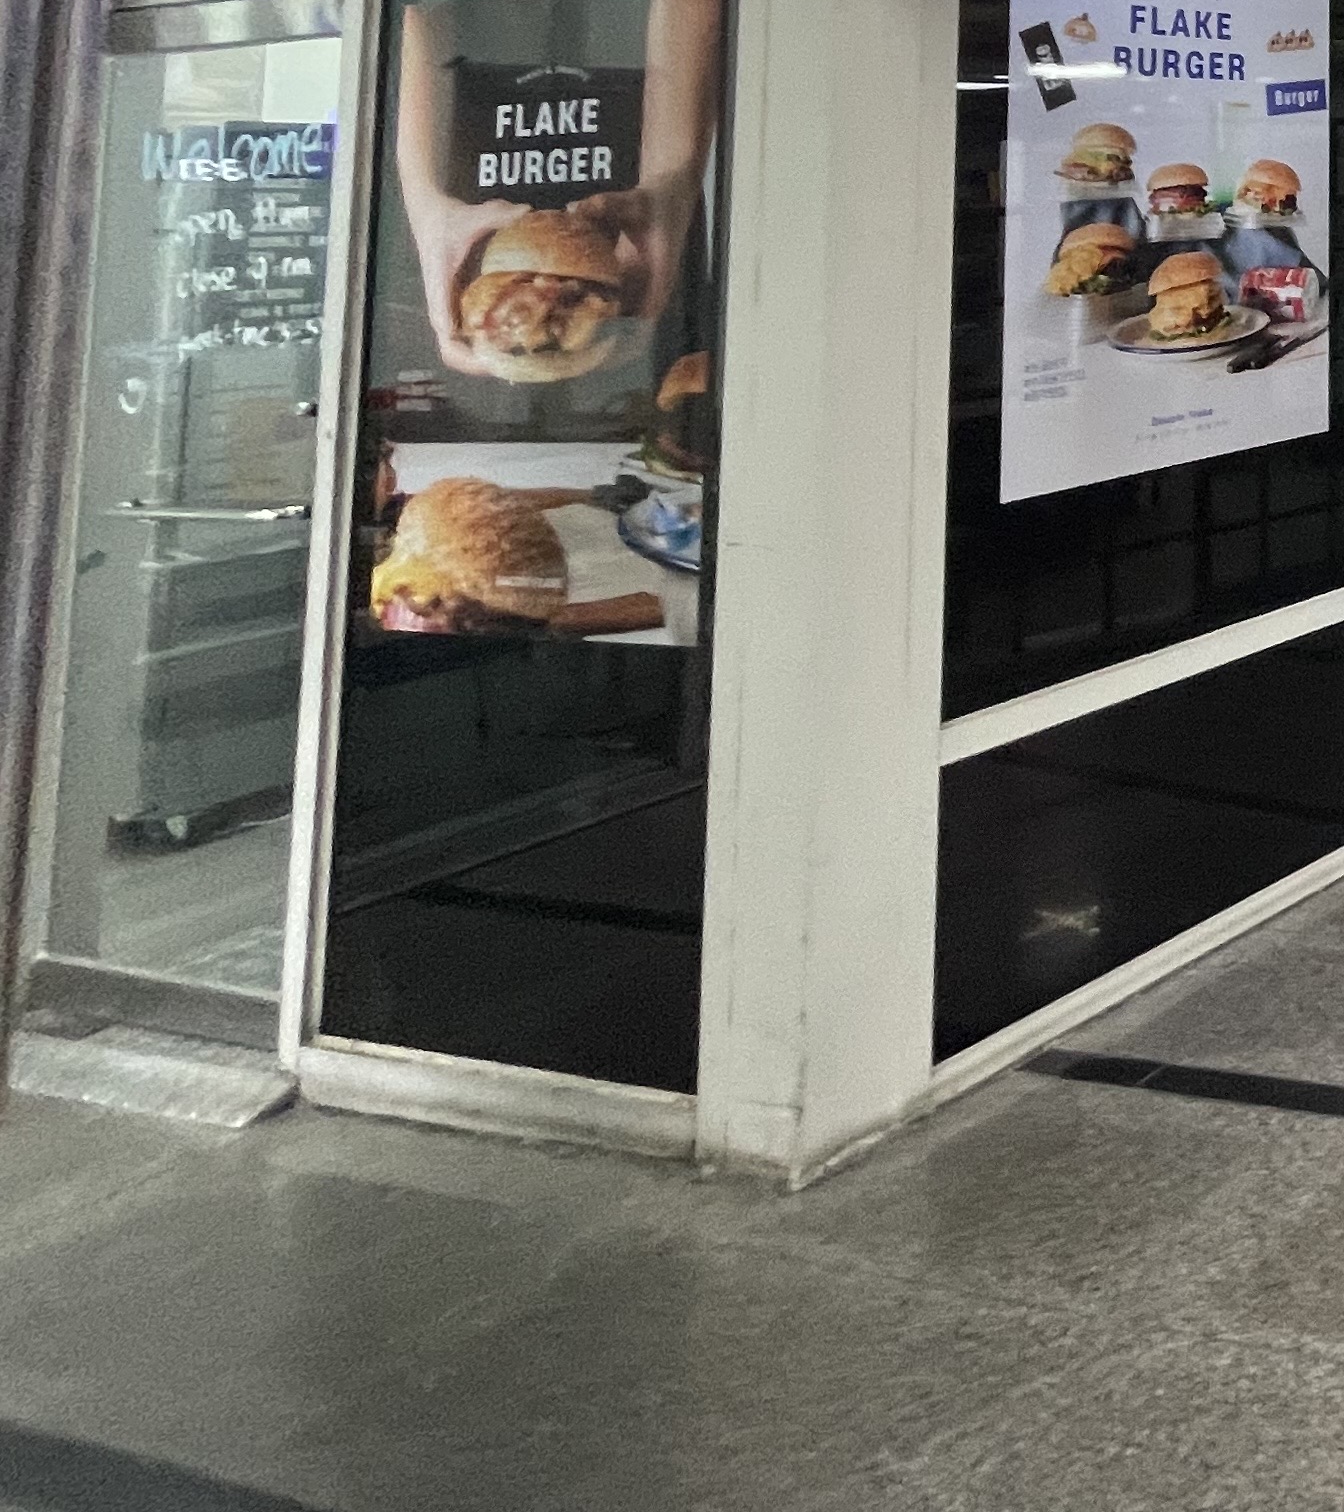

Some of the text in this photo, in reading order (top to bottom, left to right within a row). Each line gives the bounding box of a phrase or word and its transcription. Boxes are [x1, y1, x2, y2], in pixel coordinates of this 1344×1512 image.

[1130, 5, 1232, 41] FLAKE
[1113, 46, 1246, 81] BURGER
[1275, 89, 1319, 108] Burger
[496, 98, 600, 138] FLAKE
[478, 146, 612, 187] BURGER
